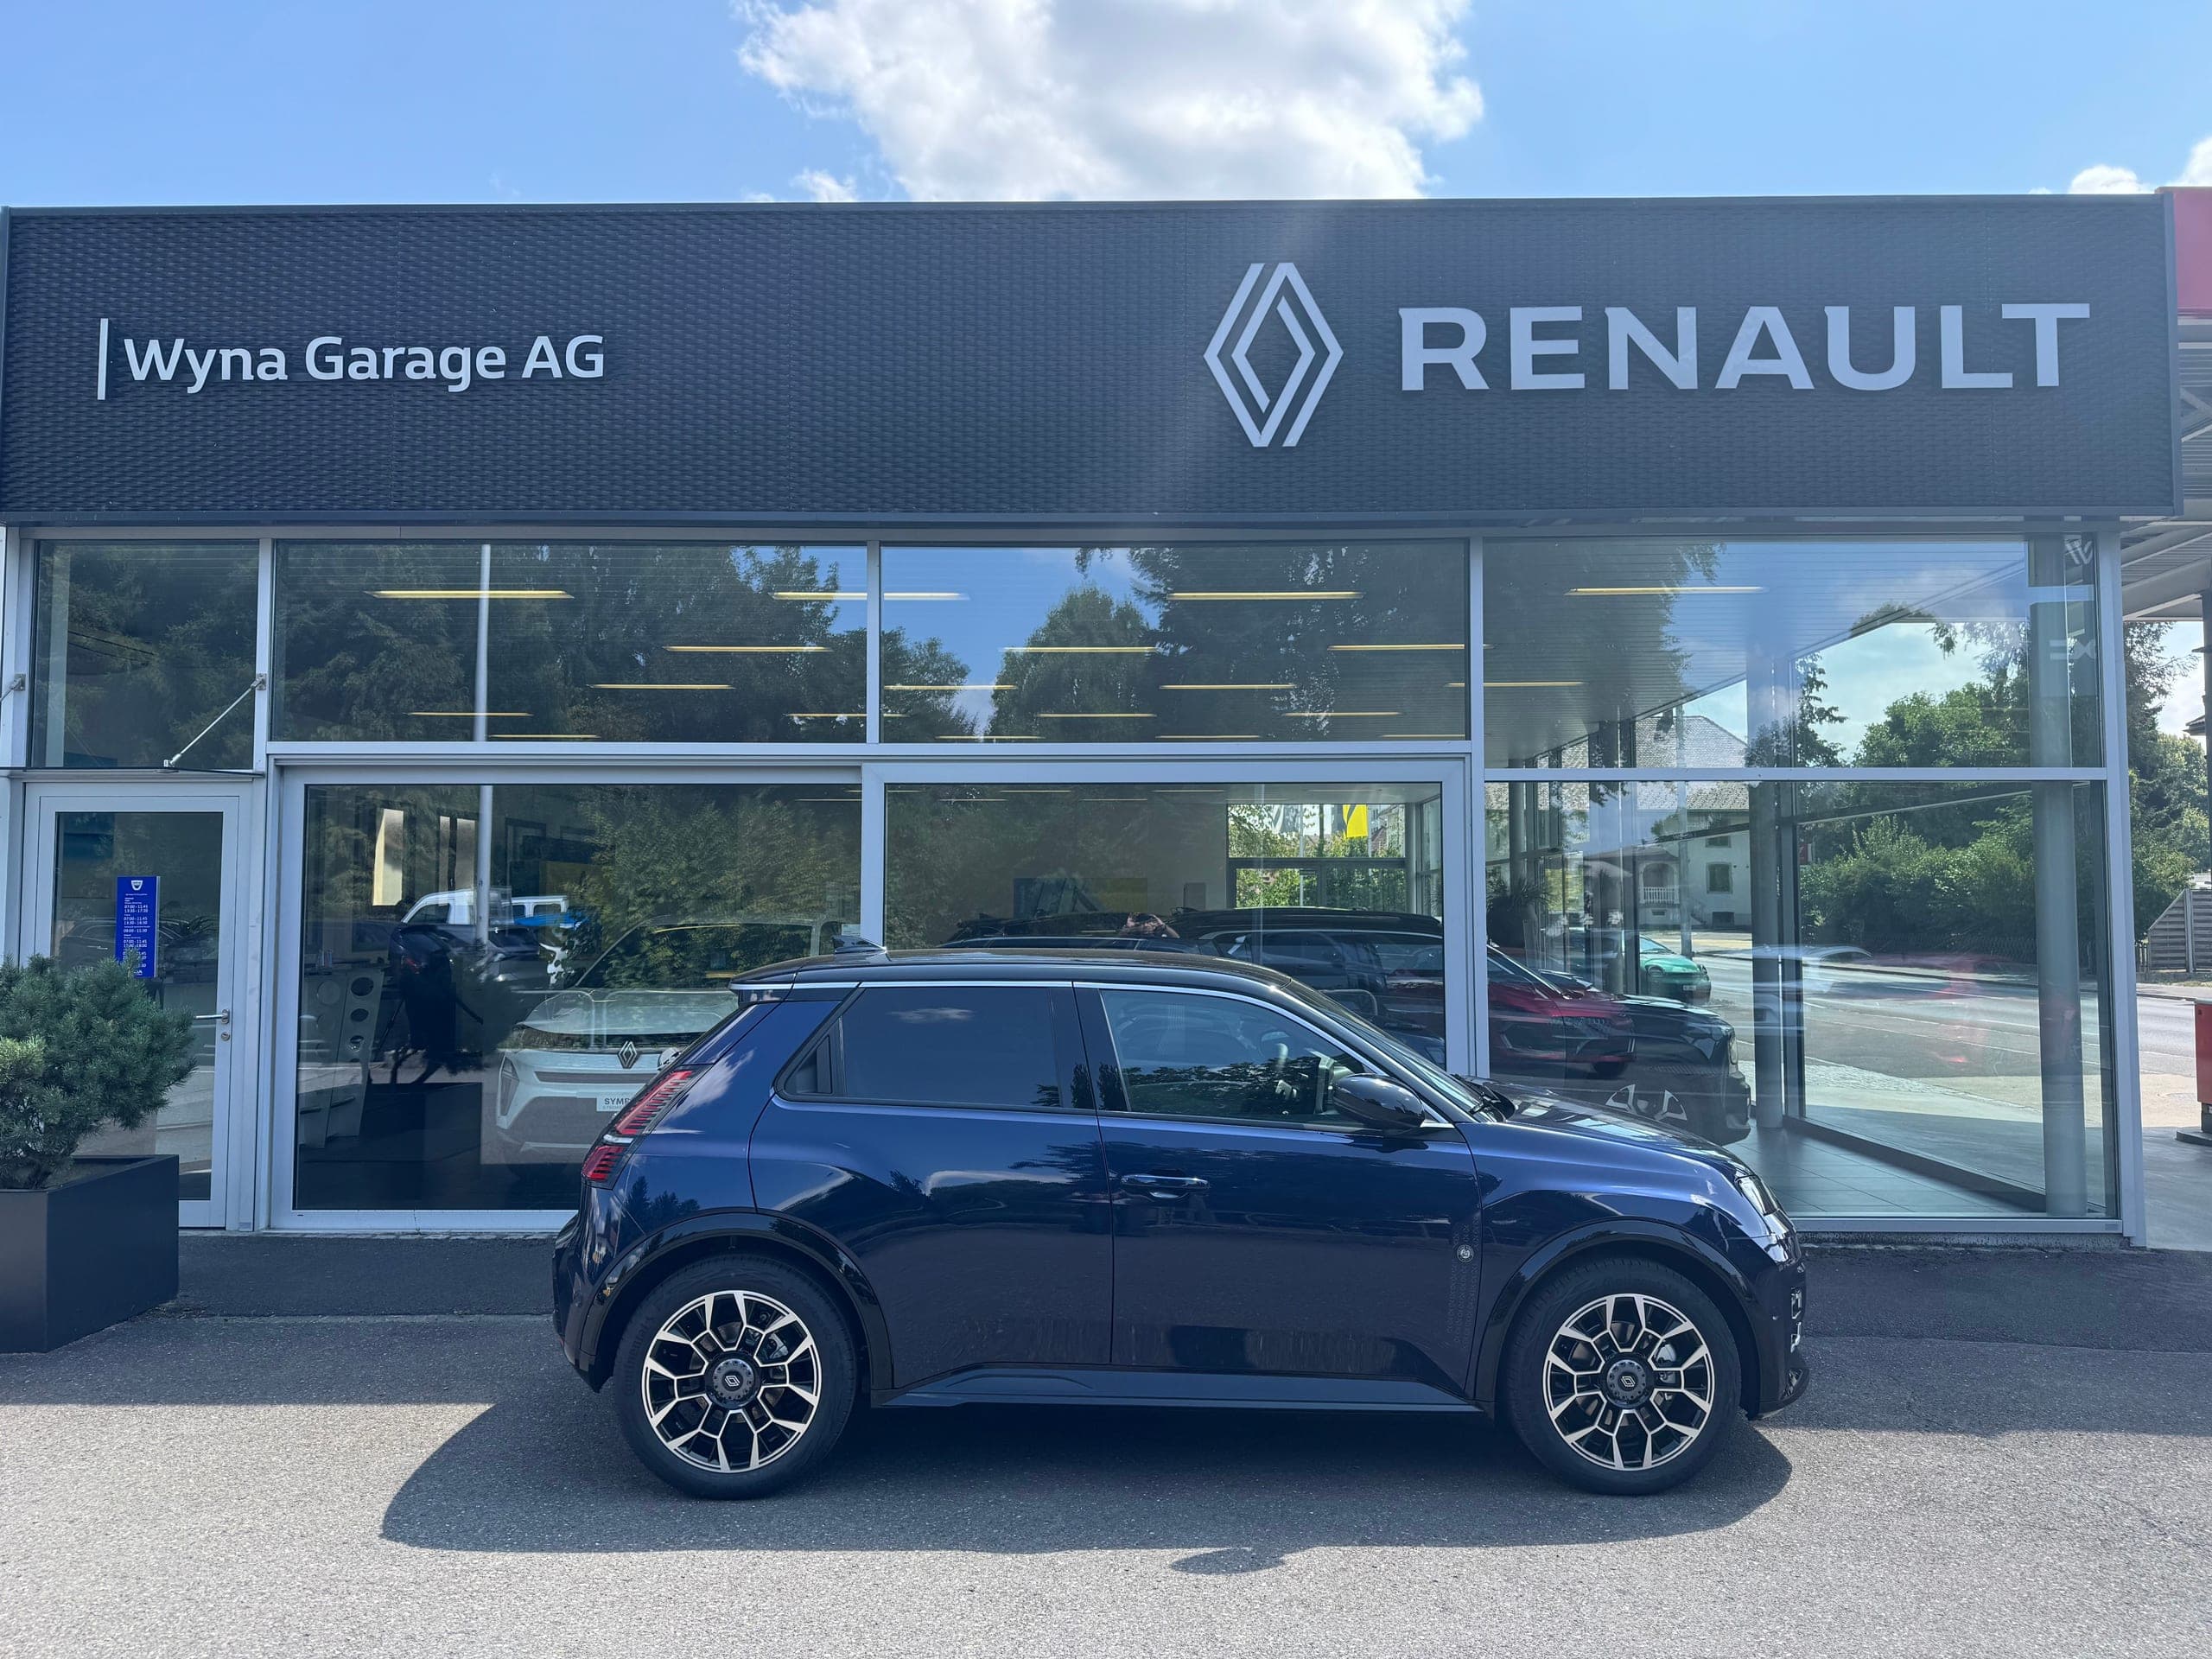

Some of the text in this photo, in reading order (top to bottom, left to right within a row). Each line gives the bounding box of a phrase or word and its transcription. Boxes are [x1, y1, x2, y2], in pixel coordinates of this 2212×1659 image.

[124, 334, 604, 394] Wyna Garage AG
[1398, 302, 2090, 391] RENAULT
